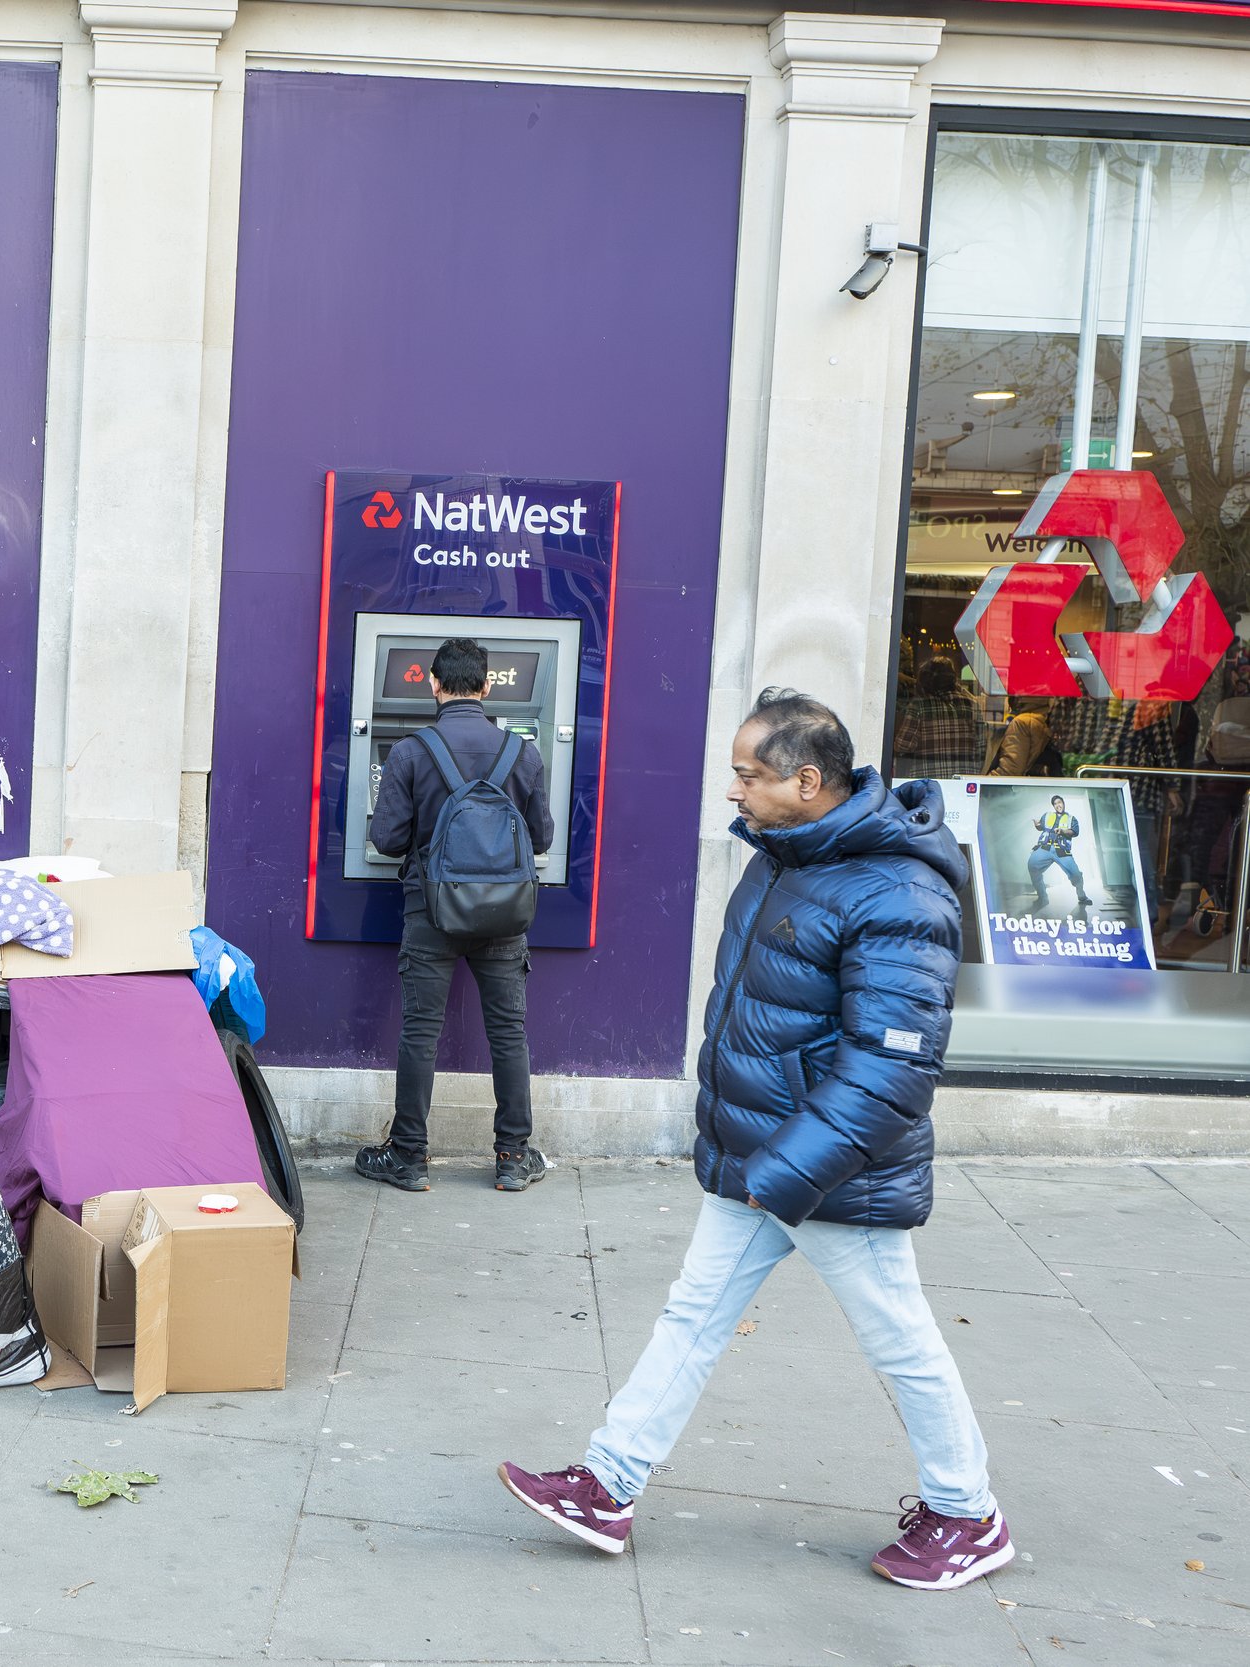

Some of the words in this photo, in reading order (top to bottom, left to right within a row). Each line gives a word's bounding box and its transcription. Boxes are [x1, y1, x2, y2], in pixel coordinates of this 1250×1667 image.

[413, 492, 587, 536] NatWest
[413, 543, 478, 567] Cash
[485, 549, 531, 569] out
[989, 912, 1062, 938] Today
[1066, 914, 1087, 935] is
[1091, 915, 1126, 935] for
[1012, 936, 1051, 956] the
[1054, 937, 1134, 962] taking
